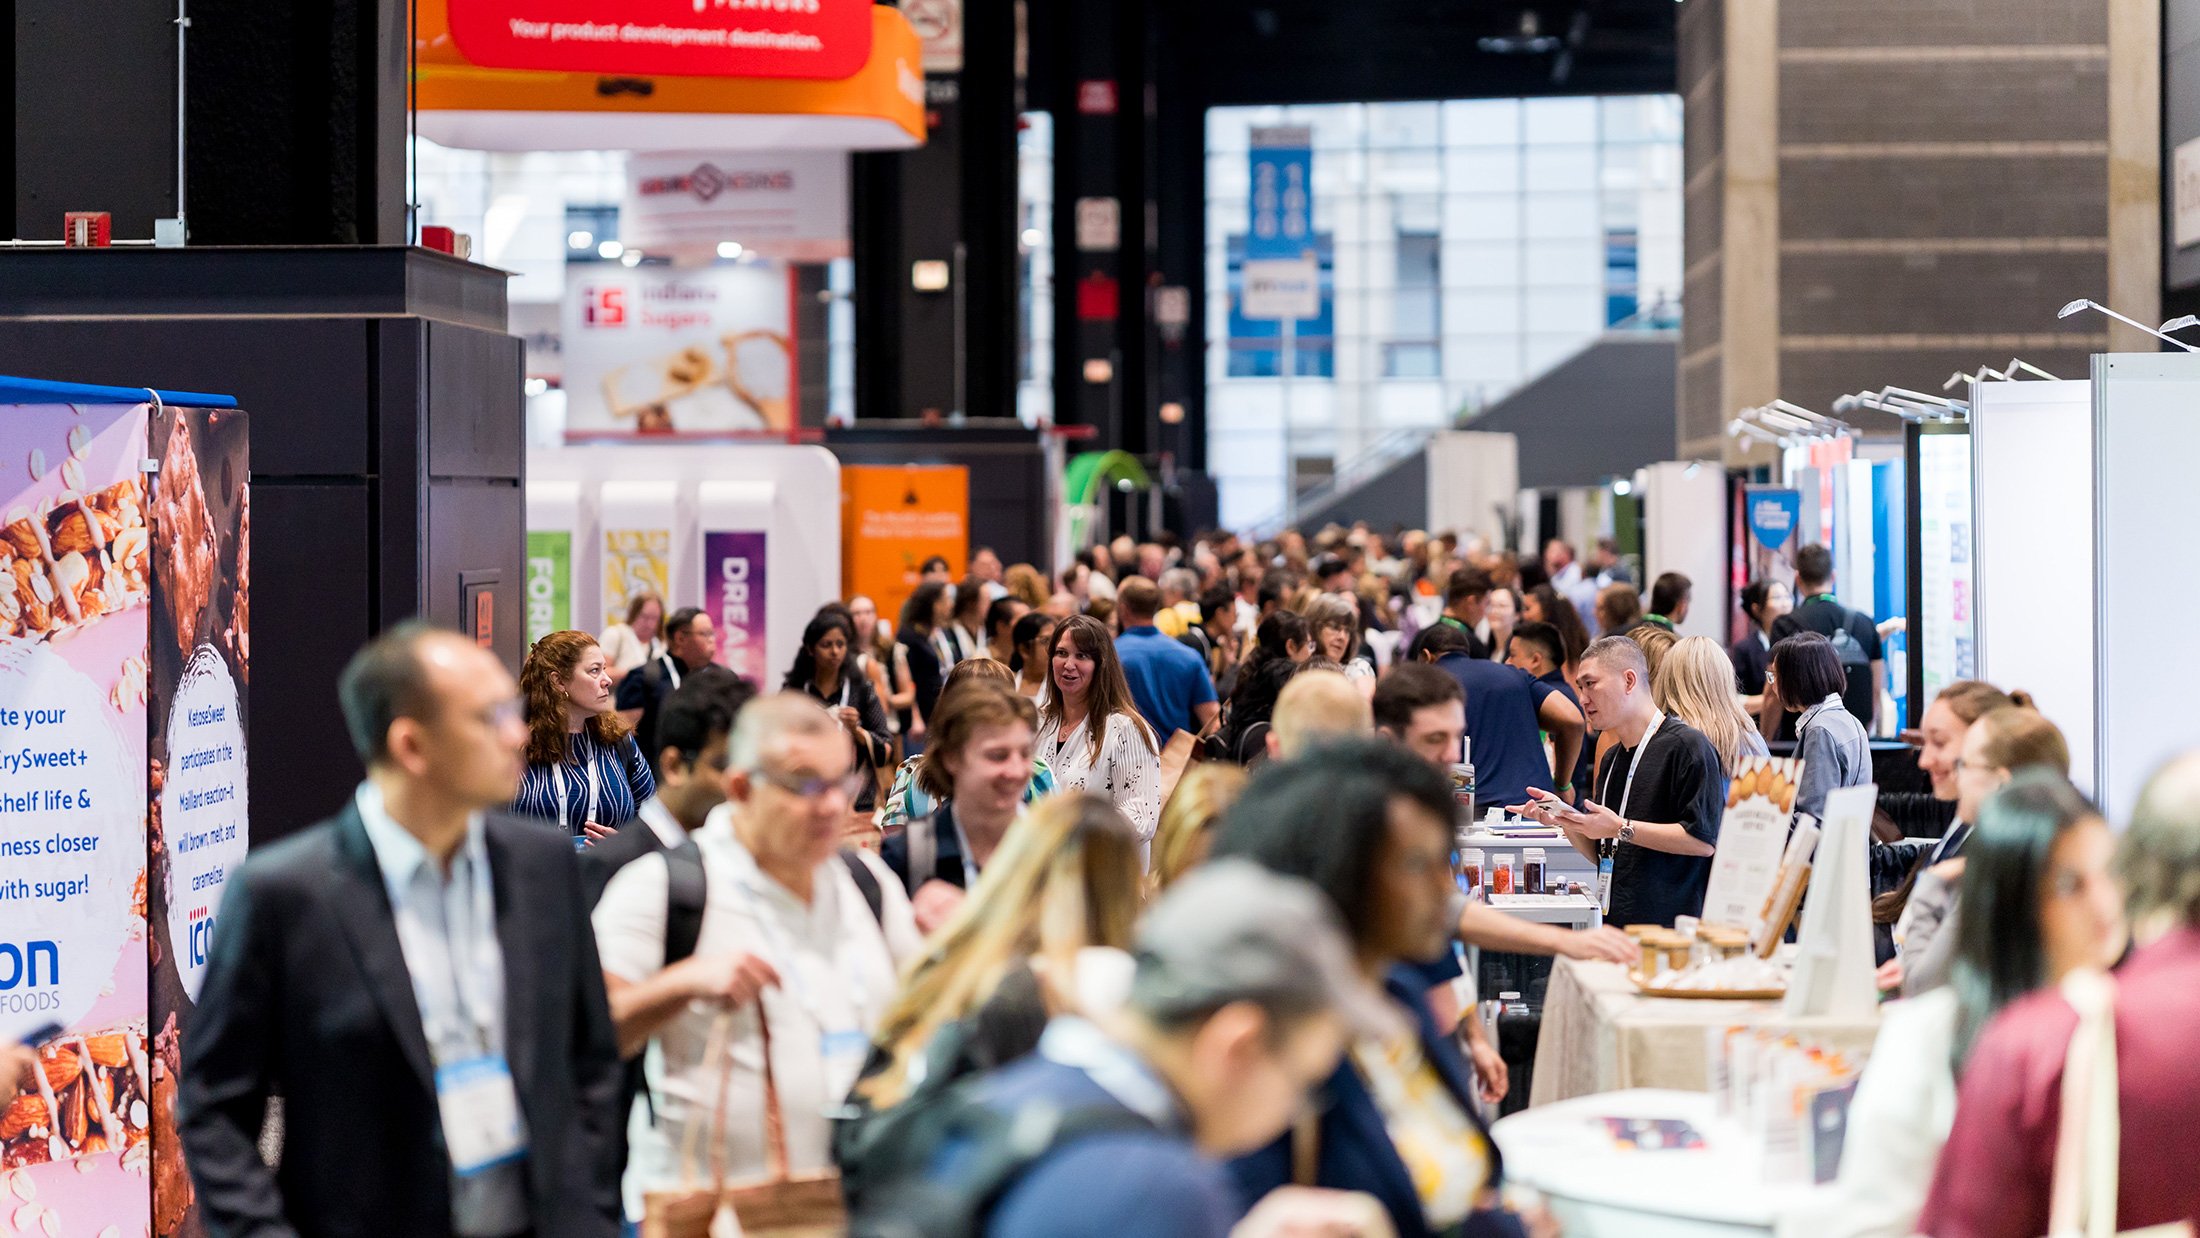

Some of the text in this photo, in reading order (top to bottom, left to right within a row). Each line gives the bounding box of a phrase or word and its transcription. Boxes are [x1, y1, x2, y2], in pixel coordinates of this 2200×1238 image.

[509, 18, 824, 51] Your product development destination.
[0, 708, 66, 731] te your
[187, 704, 226, 727] KetoseSweet
[0, 748, 88, 775] rySweet+
[181, 741, 232, 774] participates in the
[44, 789, 73, 811] life
[78, 788, 91, 809] &
[179, 786, 203, 812] Maillard
[0, 832, 99, 857] ness closer
[178, 832, 189, 854] will
[190, 831, 209, 851] brown,
[225, 819, 236, 840] and
[34, 873, 89, 902] sugar!
[188, 905, 217, 969] ico
[0, 940, 59, 991] on
[0, 990, 60, 1014] FOODS
